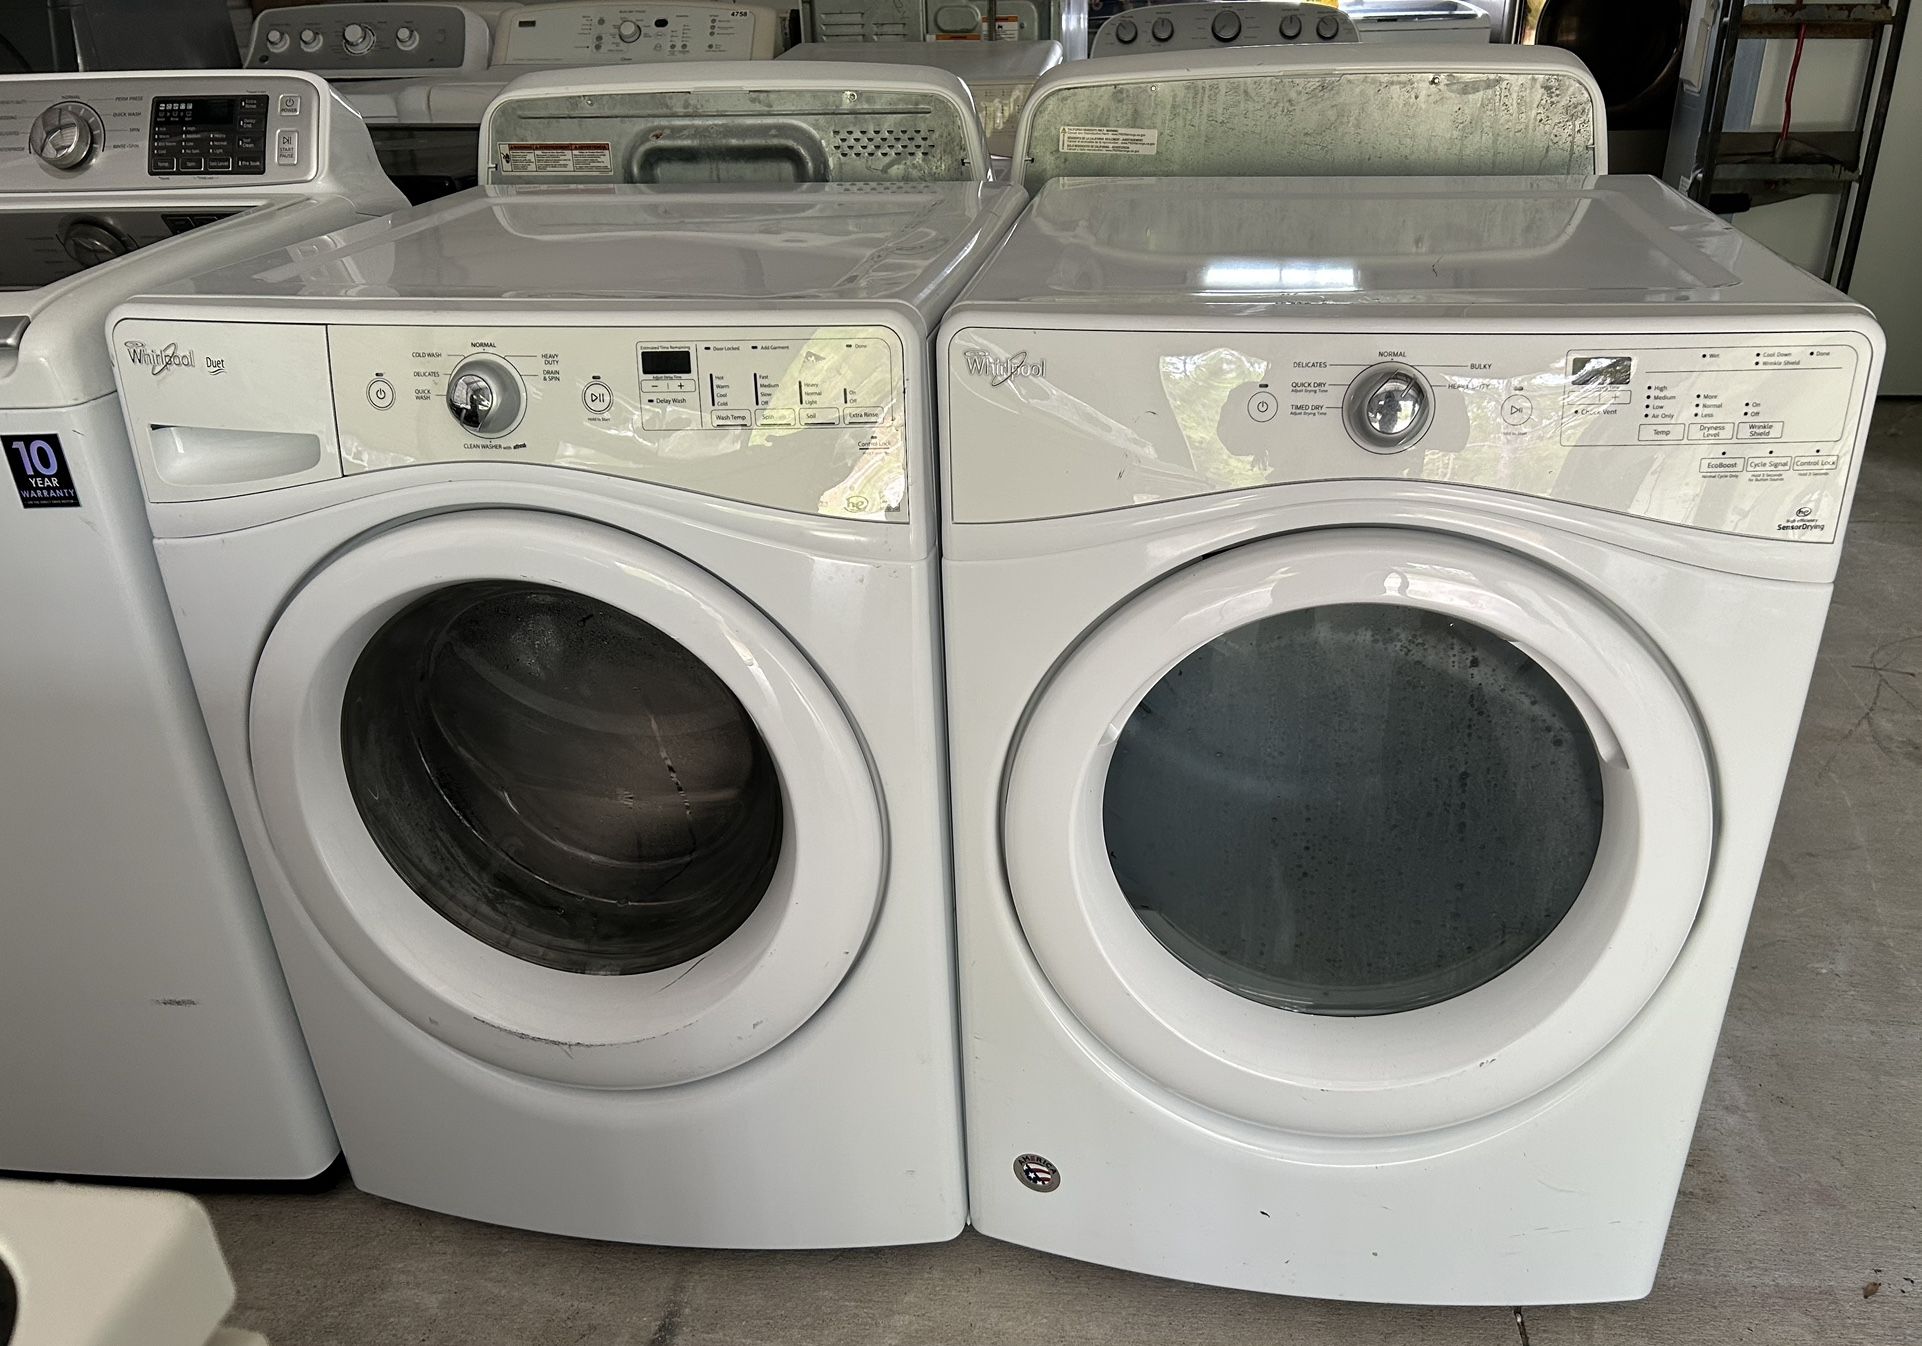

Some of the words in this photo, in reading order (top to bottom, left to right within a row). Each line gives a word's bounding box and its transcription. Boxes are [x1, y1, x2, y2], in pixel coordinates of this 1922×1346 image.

[125, 343, 195, 373] Whirlpool
[206, 357, 225, 368] Duet
[965, 352, 1046, 384] Whirlpool
[12, 440, 58, 476] 10
[28, 477, 60, 487] YEAR
[21, 489, 75, 498] WARRANTY
[1776, 524, 1825, 532] SensorDrying
[1018, 1155, 1057, 1174] AMERICA
